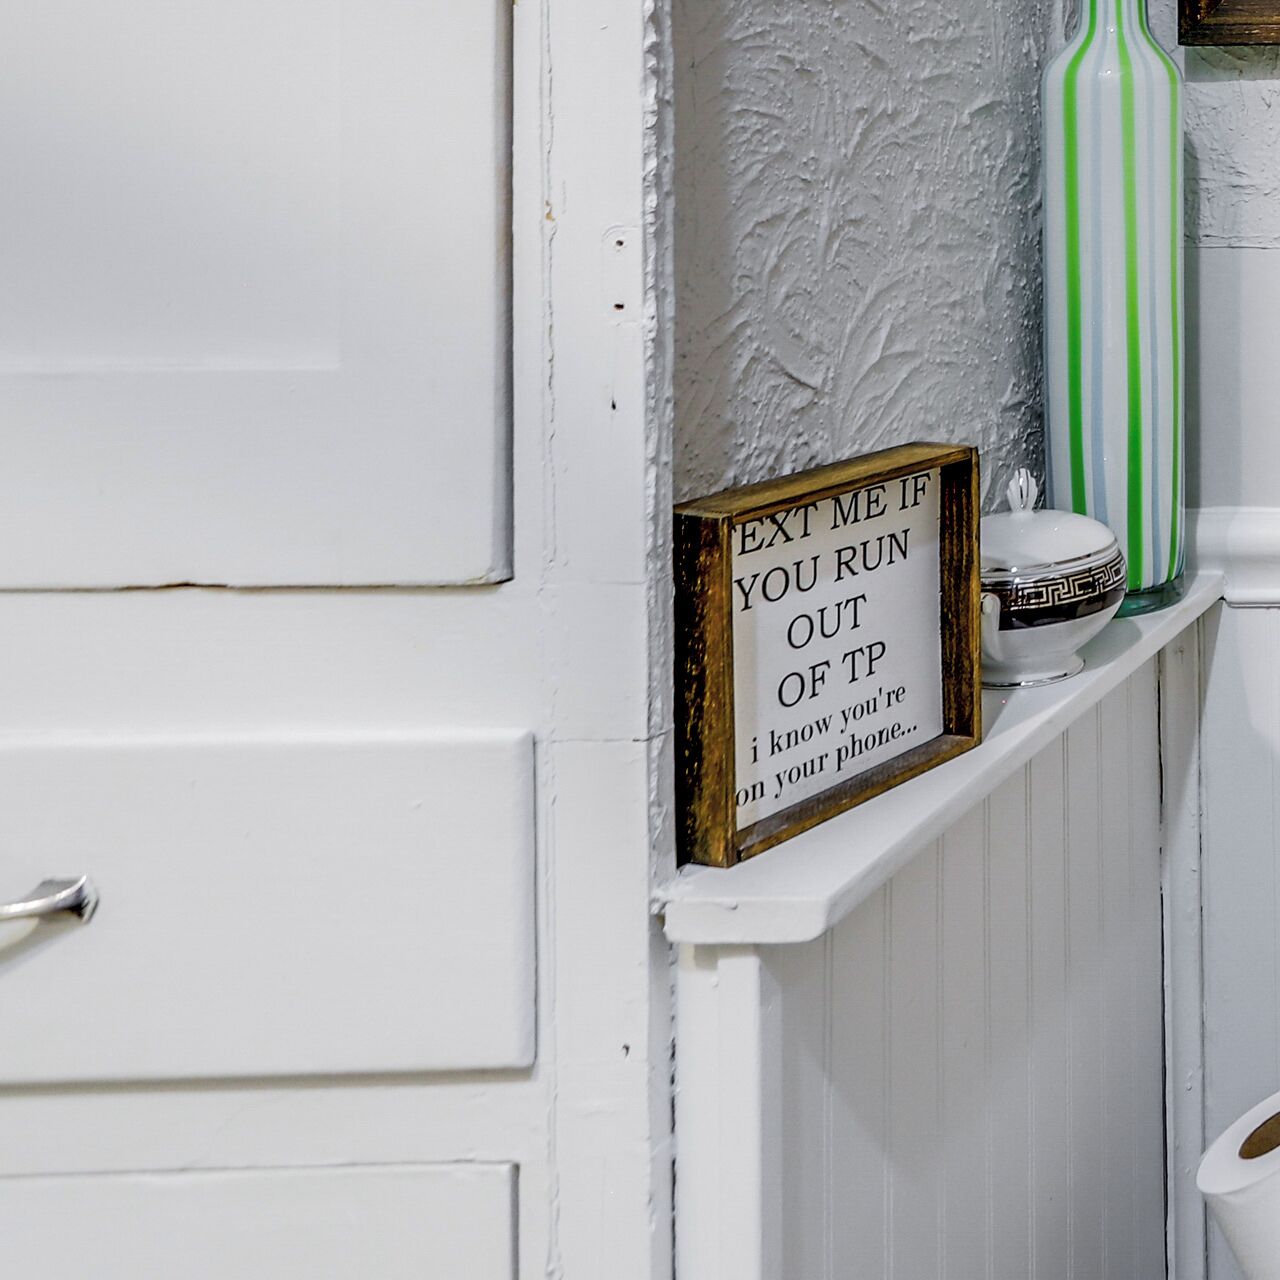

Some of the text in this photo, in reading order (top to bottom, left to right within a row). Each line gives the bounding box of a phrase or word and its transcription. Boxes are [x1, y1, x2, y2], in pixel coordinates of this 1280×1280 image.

[732, 472, 931, 556] EXT ME IF
[733, 528, 910, 611] YOU RUN
[786, 594, 867, 649] OUT
[777, 641, 886, 708] OF TP
[735, 721, 918, 807] on your phone...
[751, 685, 906, 764] i know you're
